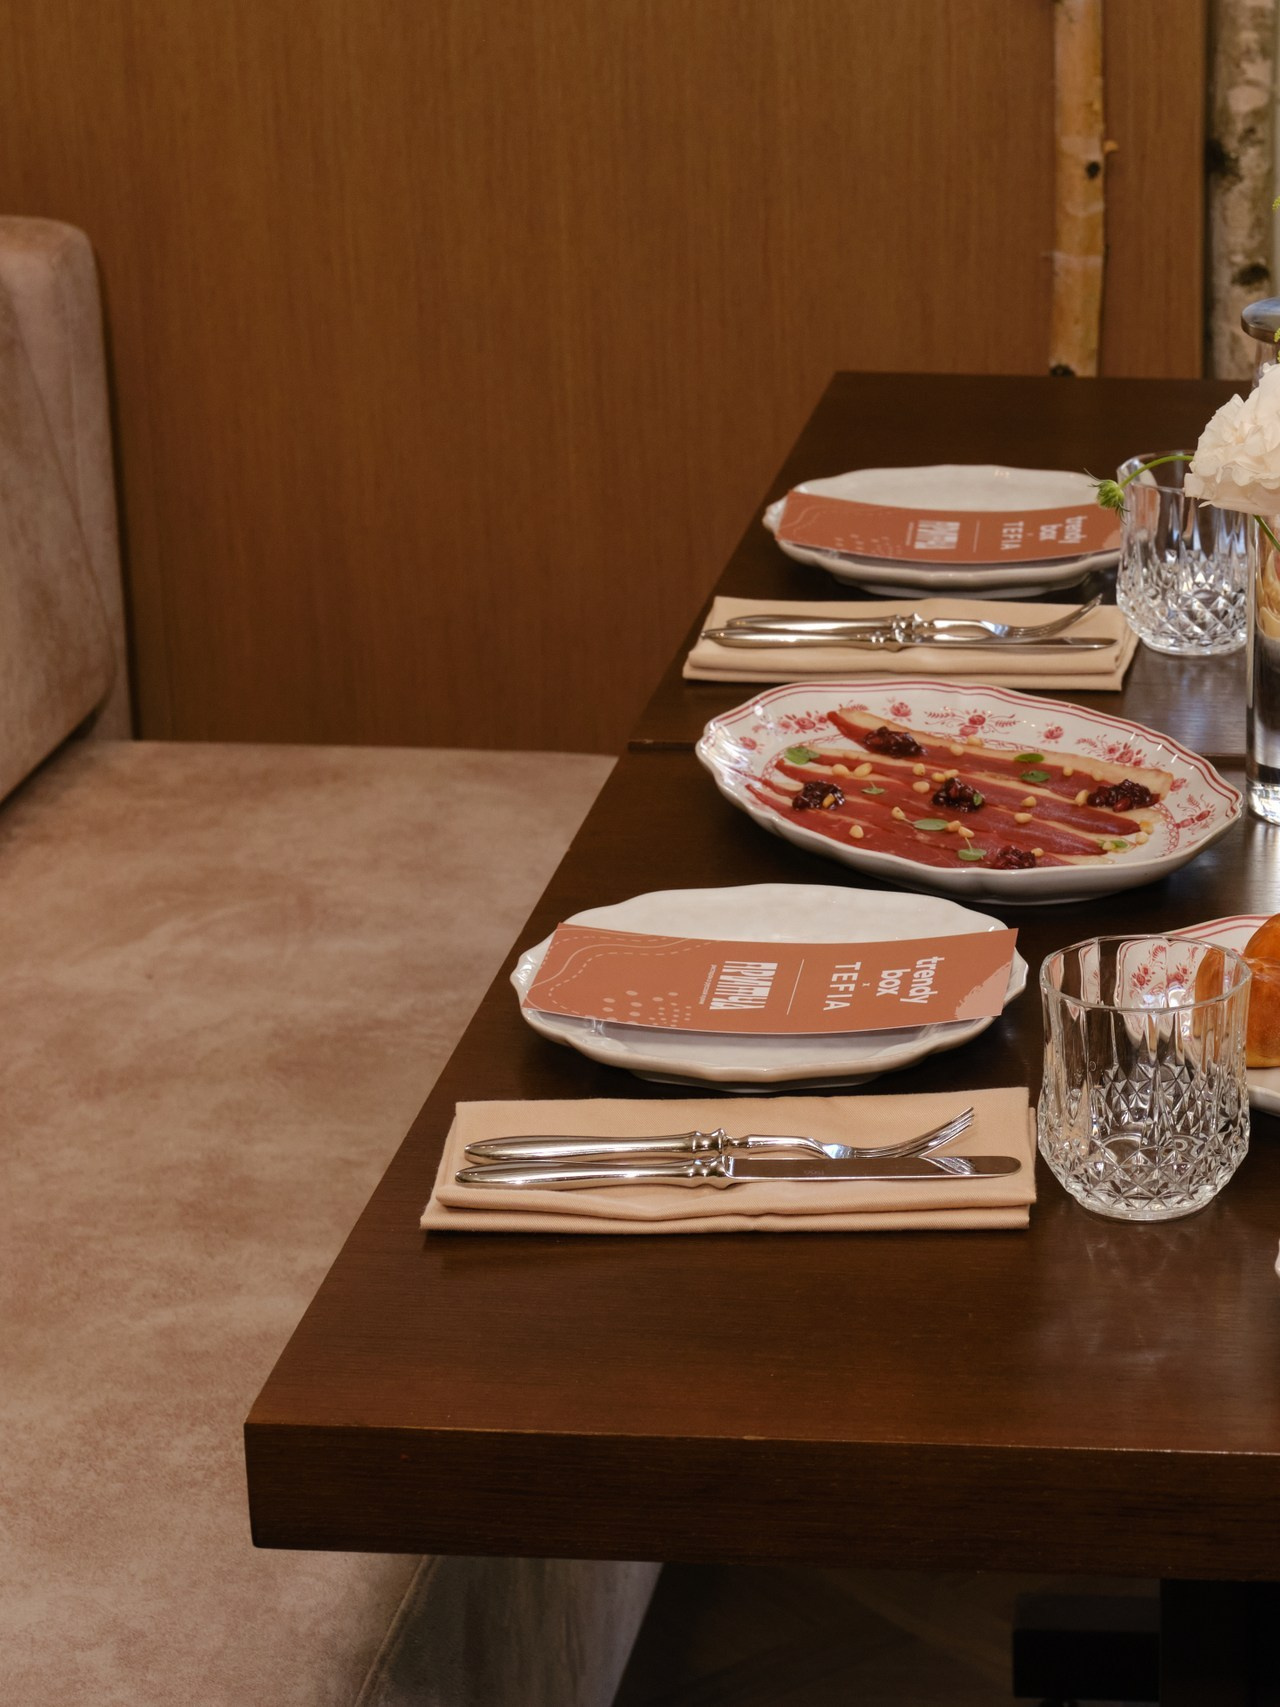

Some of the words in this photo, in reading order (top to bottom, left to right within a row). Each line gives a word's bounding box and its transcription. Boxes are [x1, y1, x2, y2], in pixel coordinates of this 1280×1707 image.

[1000, 520, 1024, 550] TEFIA
[709, 960, 778, 1010] ПРИТЧА
[823, 961, 862, 1011] TEFIA
[876, 968, 911, 997] box
[900, 956, 945, 1004] trendy
